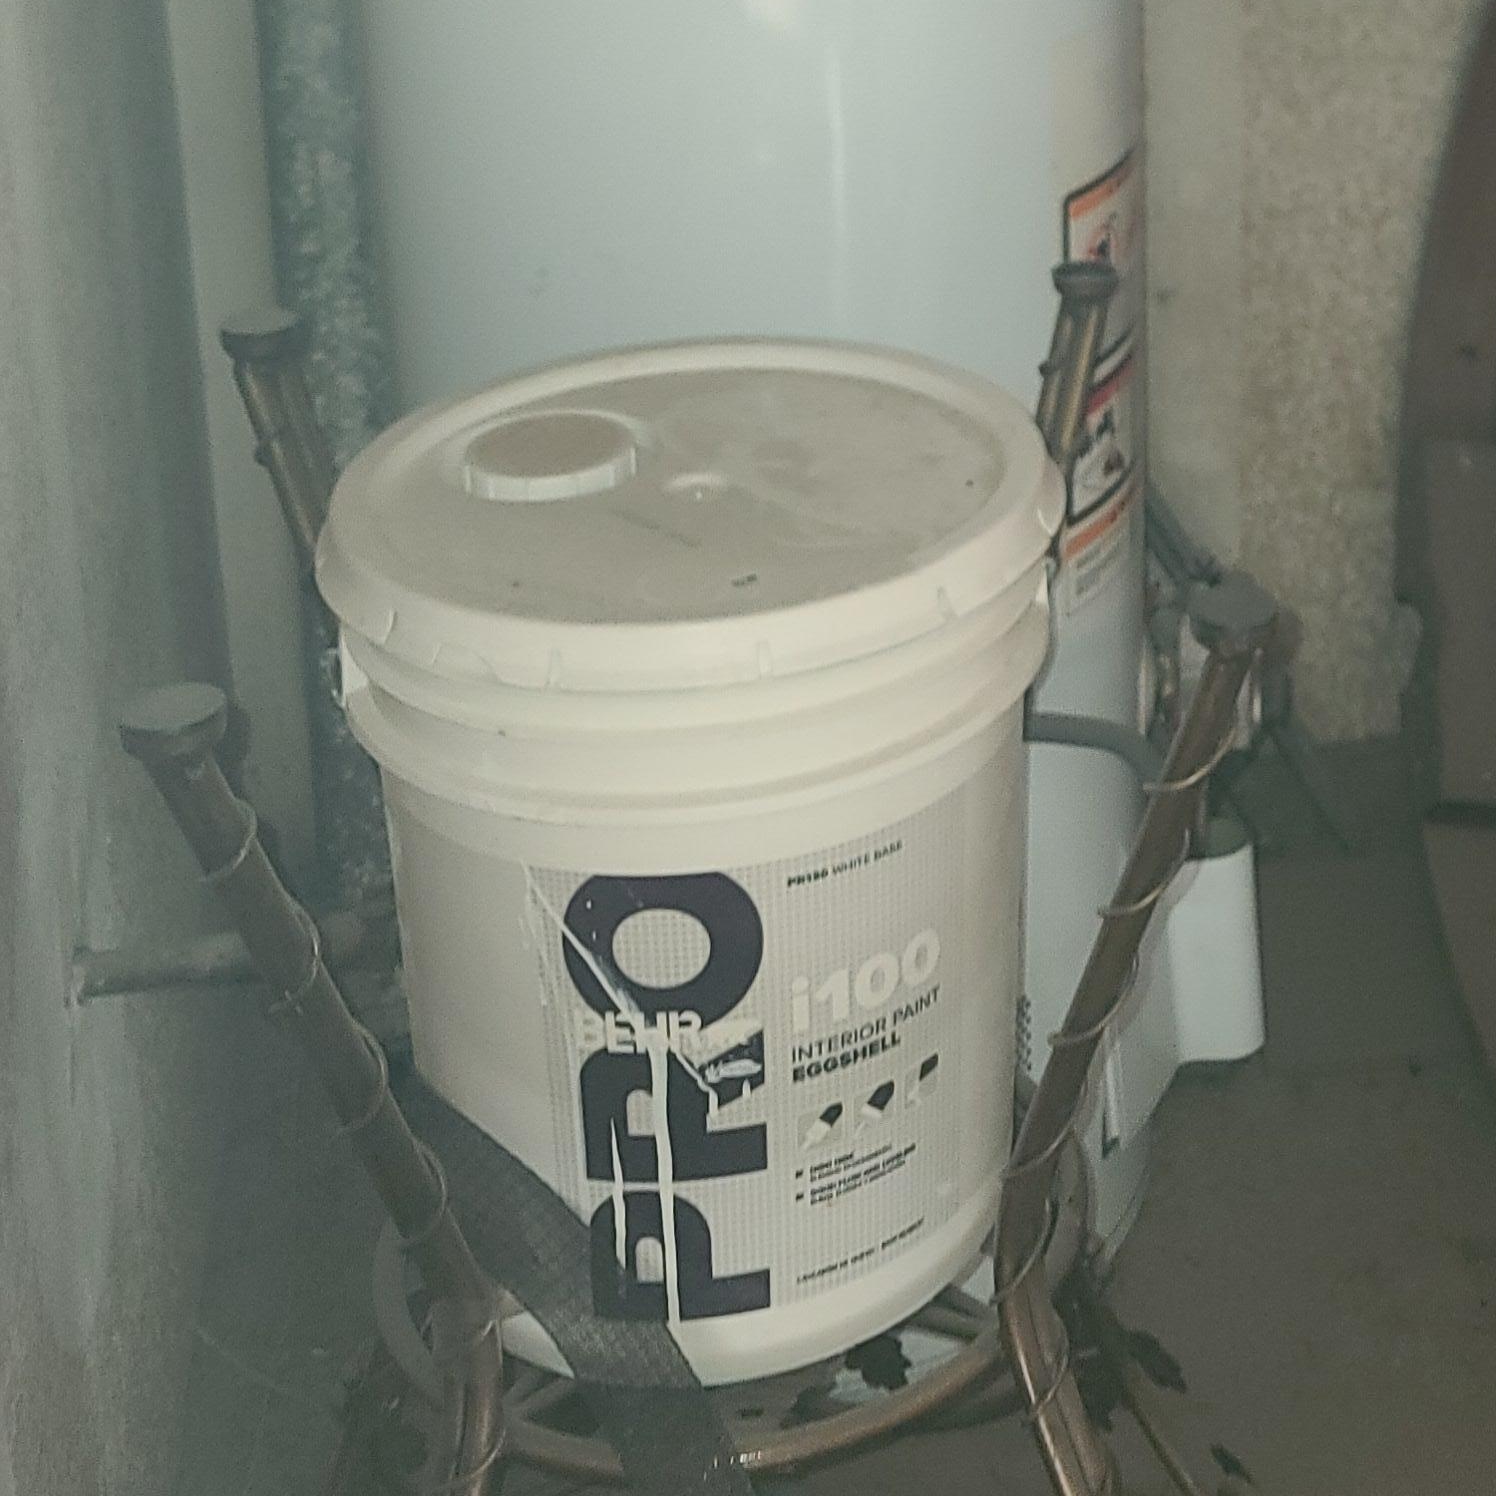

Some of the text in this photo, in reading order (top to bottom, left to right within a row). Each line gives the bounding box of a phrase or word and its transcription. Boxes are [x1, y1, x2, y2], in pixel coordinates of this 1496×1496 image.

[792, 929, 940, 1034] i100
[578, 1010, 702, 1054] BEHR
[792, 983, 940, 1063] INTERIOR PAINT
[792, 1030, 901, 1084] EGGSHELL
[562, 871, 771, 1321] PRO
